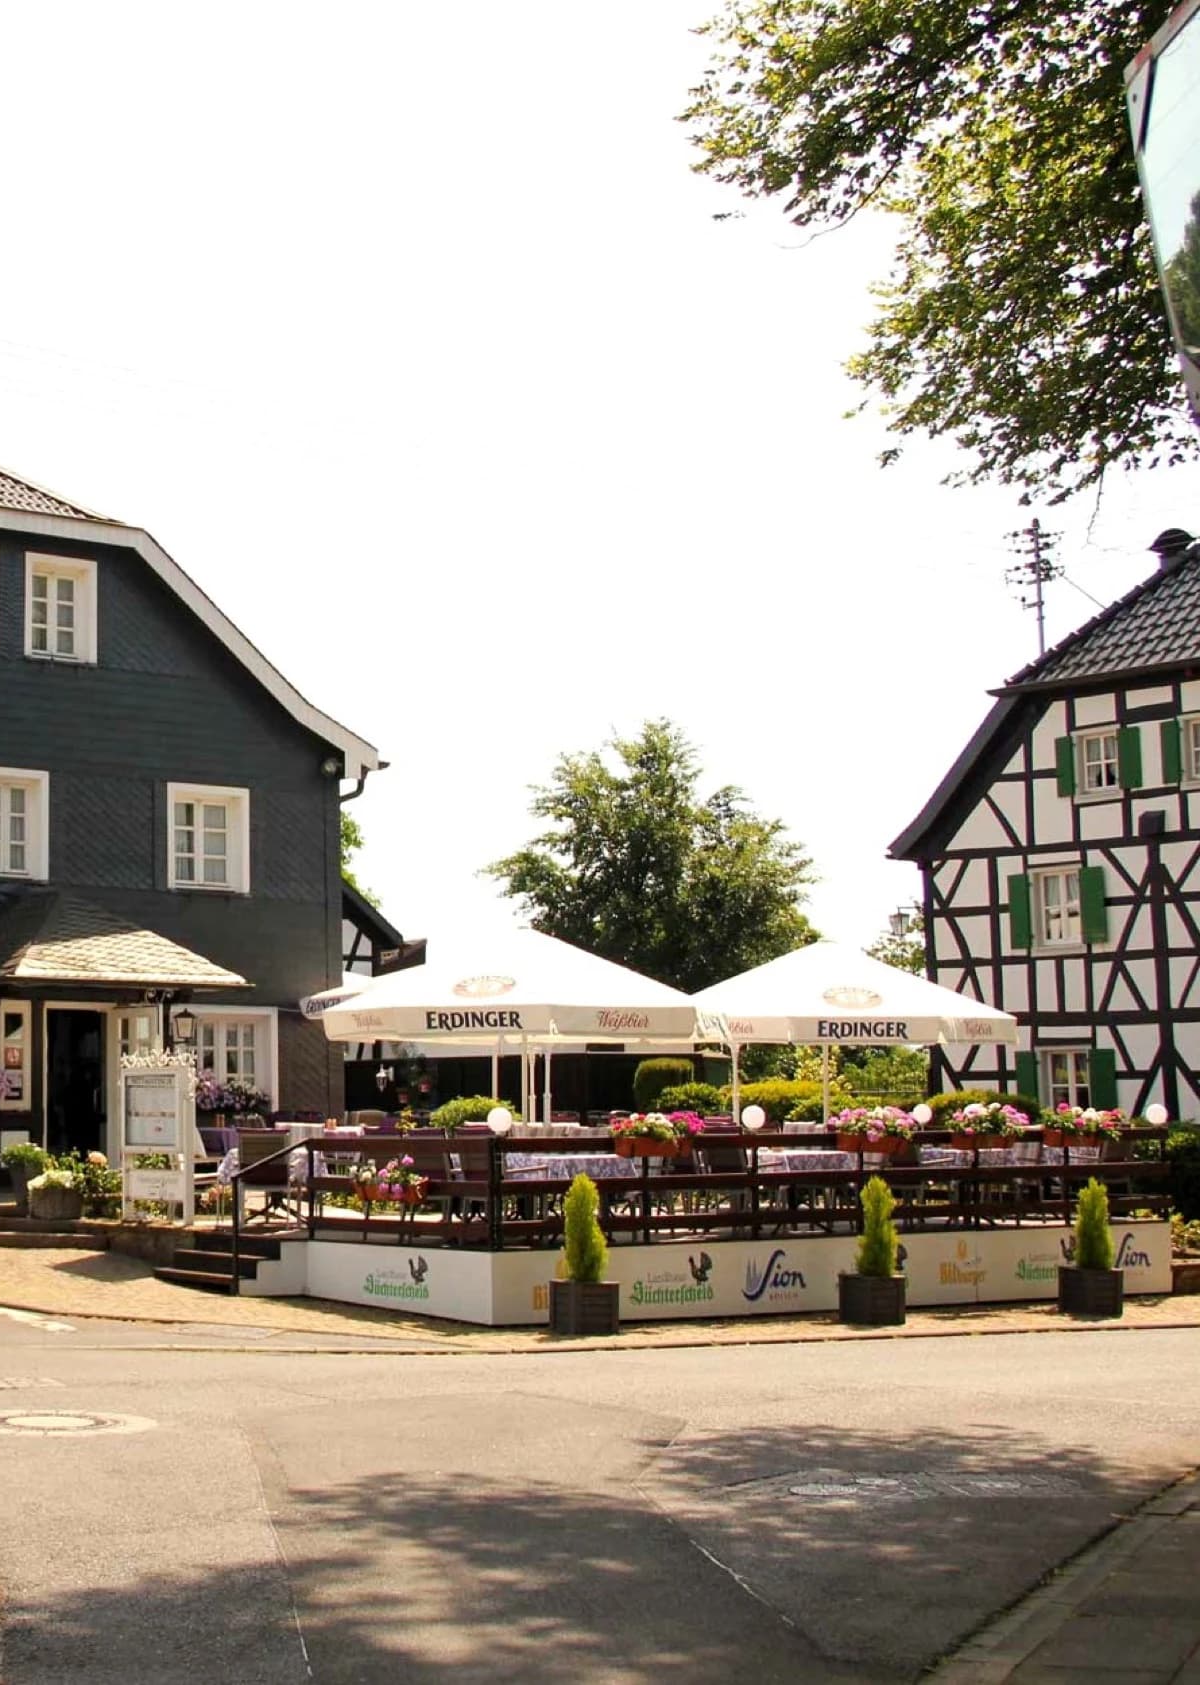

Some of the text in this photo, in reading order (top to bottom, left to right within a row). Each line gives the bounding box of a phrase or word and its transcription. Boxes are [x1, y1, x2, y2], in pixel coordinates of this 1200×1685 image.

[425, 1011, 522, 1031] ERDINGER
[597, 1009, 649, 1031] Weißbier
[817, 1019, 908, 1040] ERDINGER
